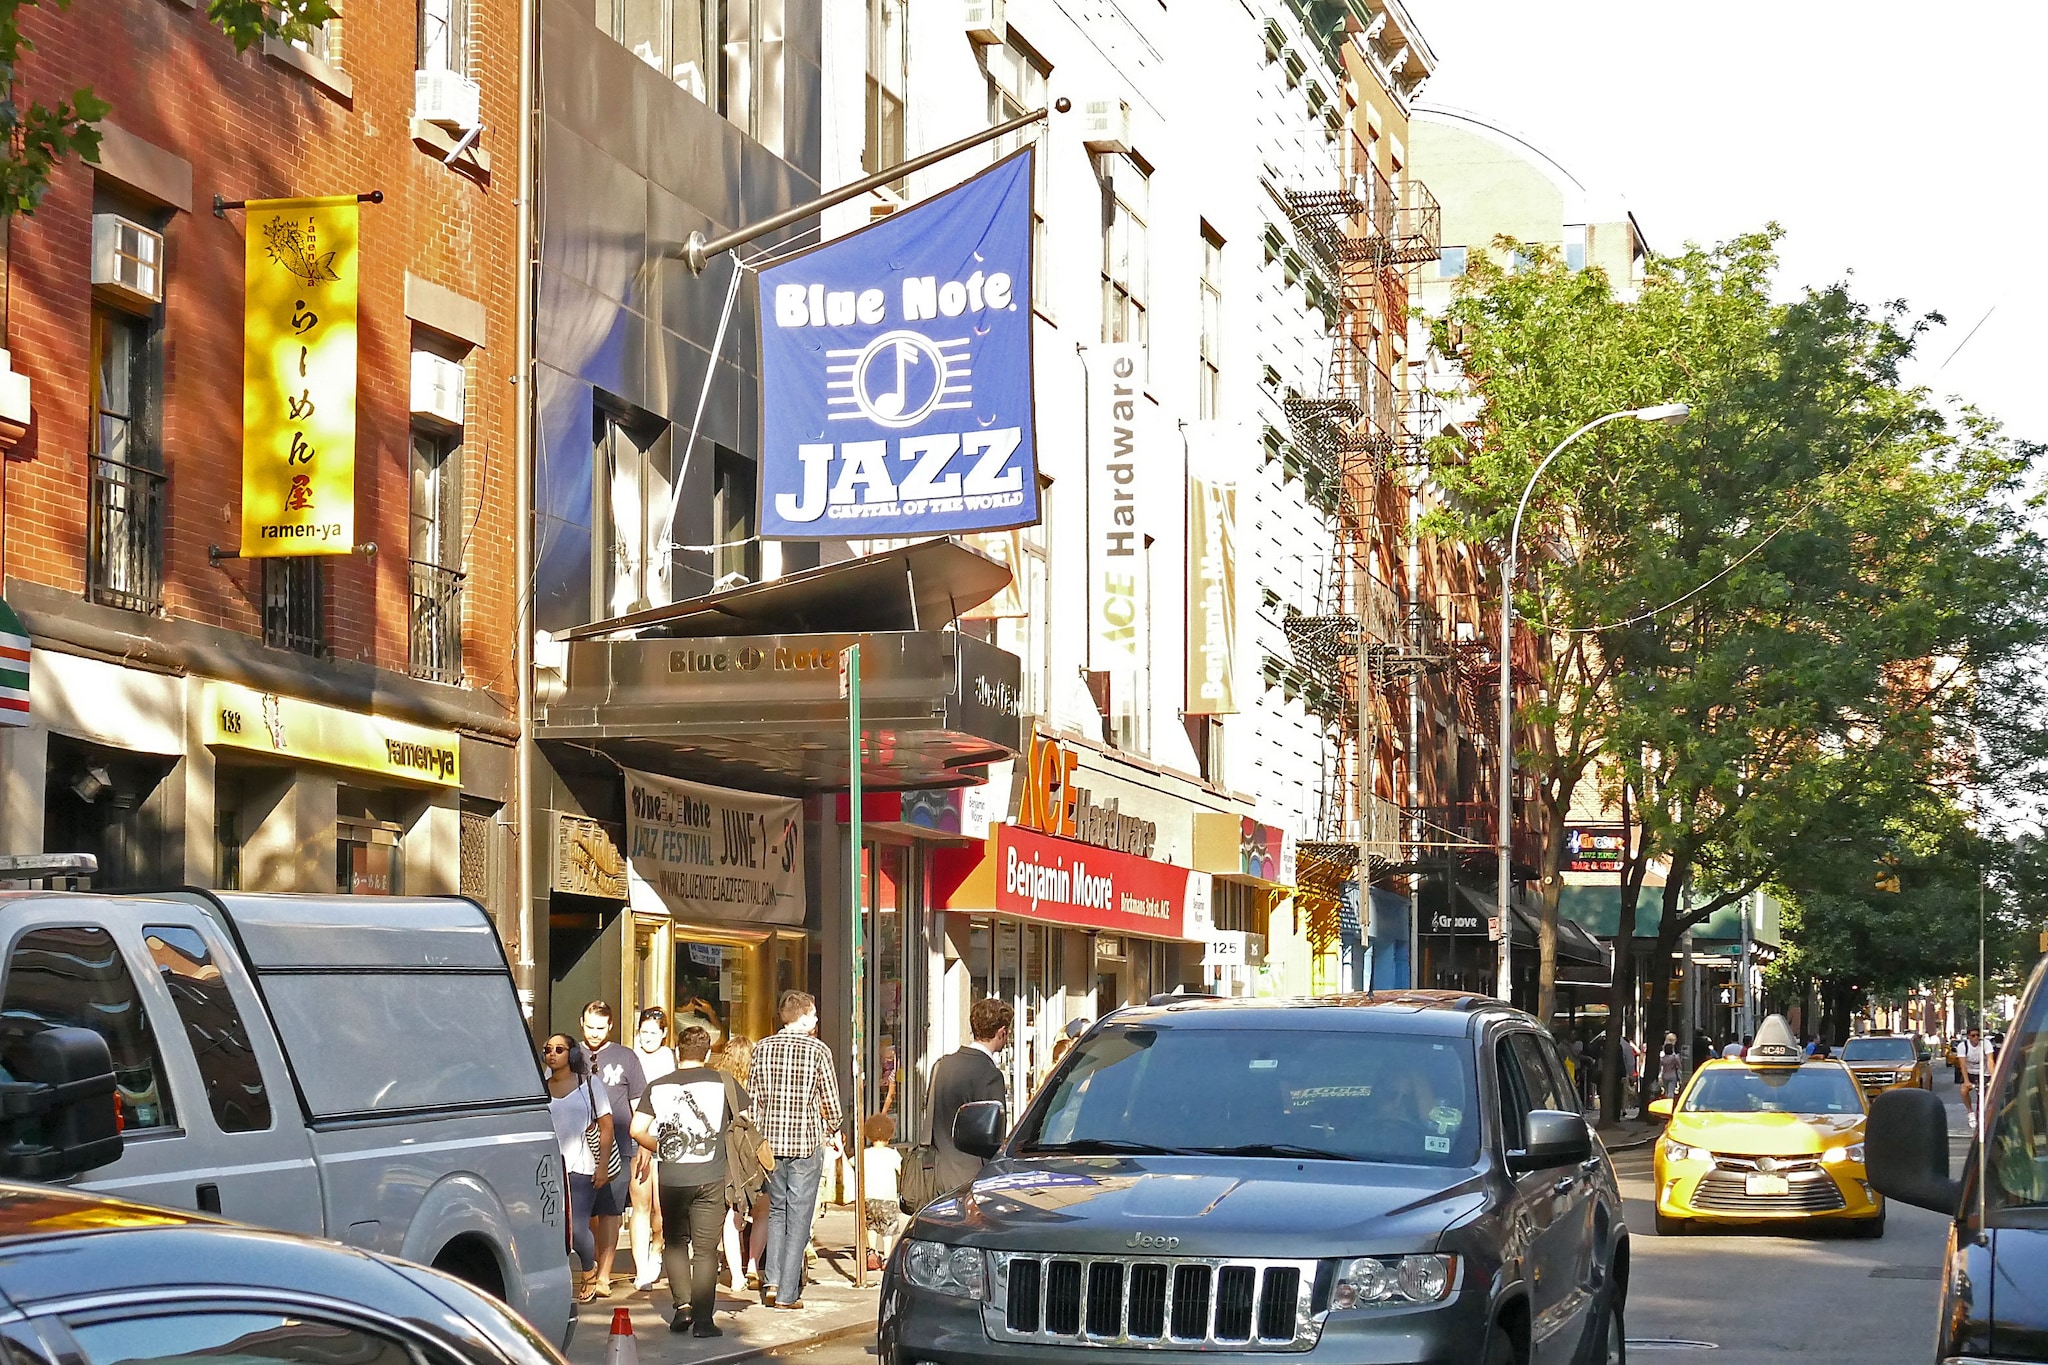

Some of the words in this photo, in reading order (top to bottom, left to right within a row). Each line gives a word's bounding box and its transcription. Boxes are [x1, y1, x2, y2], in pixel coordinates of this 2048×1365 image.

[775, 284, 887, 328] Blue
[284, 300, 319, 512] らーめん屋
[775, 427, 1023, 522] JAZZ
[1106, 356, 1135, 556] Hardware
[828, 502, 900, 519] CAPITAL
[903, 501, 927, 515] OF
[929, 498, 964, 513] THE
[967, 492, 1024, 511] WORLD
[261, 523, 342, 541] ramen-ya
[1101, 570, 1136, 655] ACE
[668, 650, 727, 673] Blue
[773, 647, 835, 671] Note
[222, 709, 241, 733] 133
[385, 738, 454, 780] ramen-ya
[632, 786, 662, 822] Blue
[683, 795, 711, 829] Note
[1018, 719, 1078, 838] ACE
[1077, 787, 1157, 858] Hardware
[631, 825, 659, 859] JAZZ
[661, 830, 715, 867] FESTIVAL
[720, 808, 757, 869] JUNE
[758, 814, 767, 870] 1
[659, 870, 777, 907] WWW.BLUENOTEJAZZFESTIVAL.COM
[1006, 845, 1071, 912] Benjamin
[1072, 861, 1113, 911] Moore
[1160, 899, 1170, 920] ACE
[1212, 942, 1238, 954] 125
[1761, 1046, 1786, 1055] 4C49
[1126, 1231, 1180, 1252] Jeep
